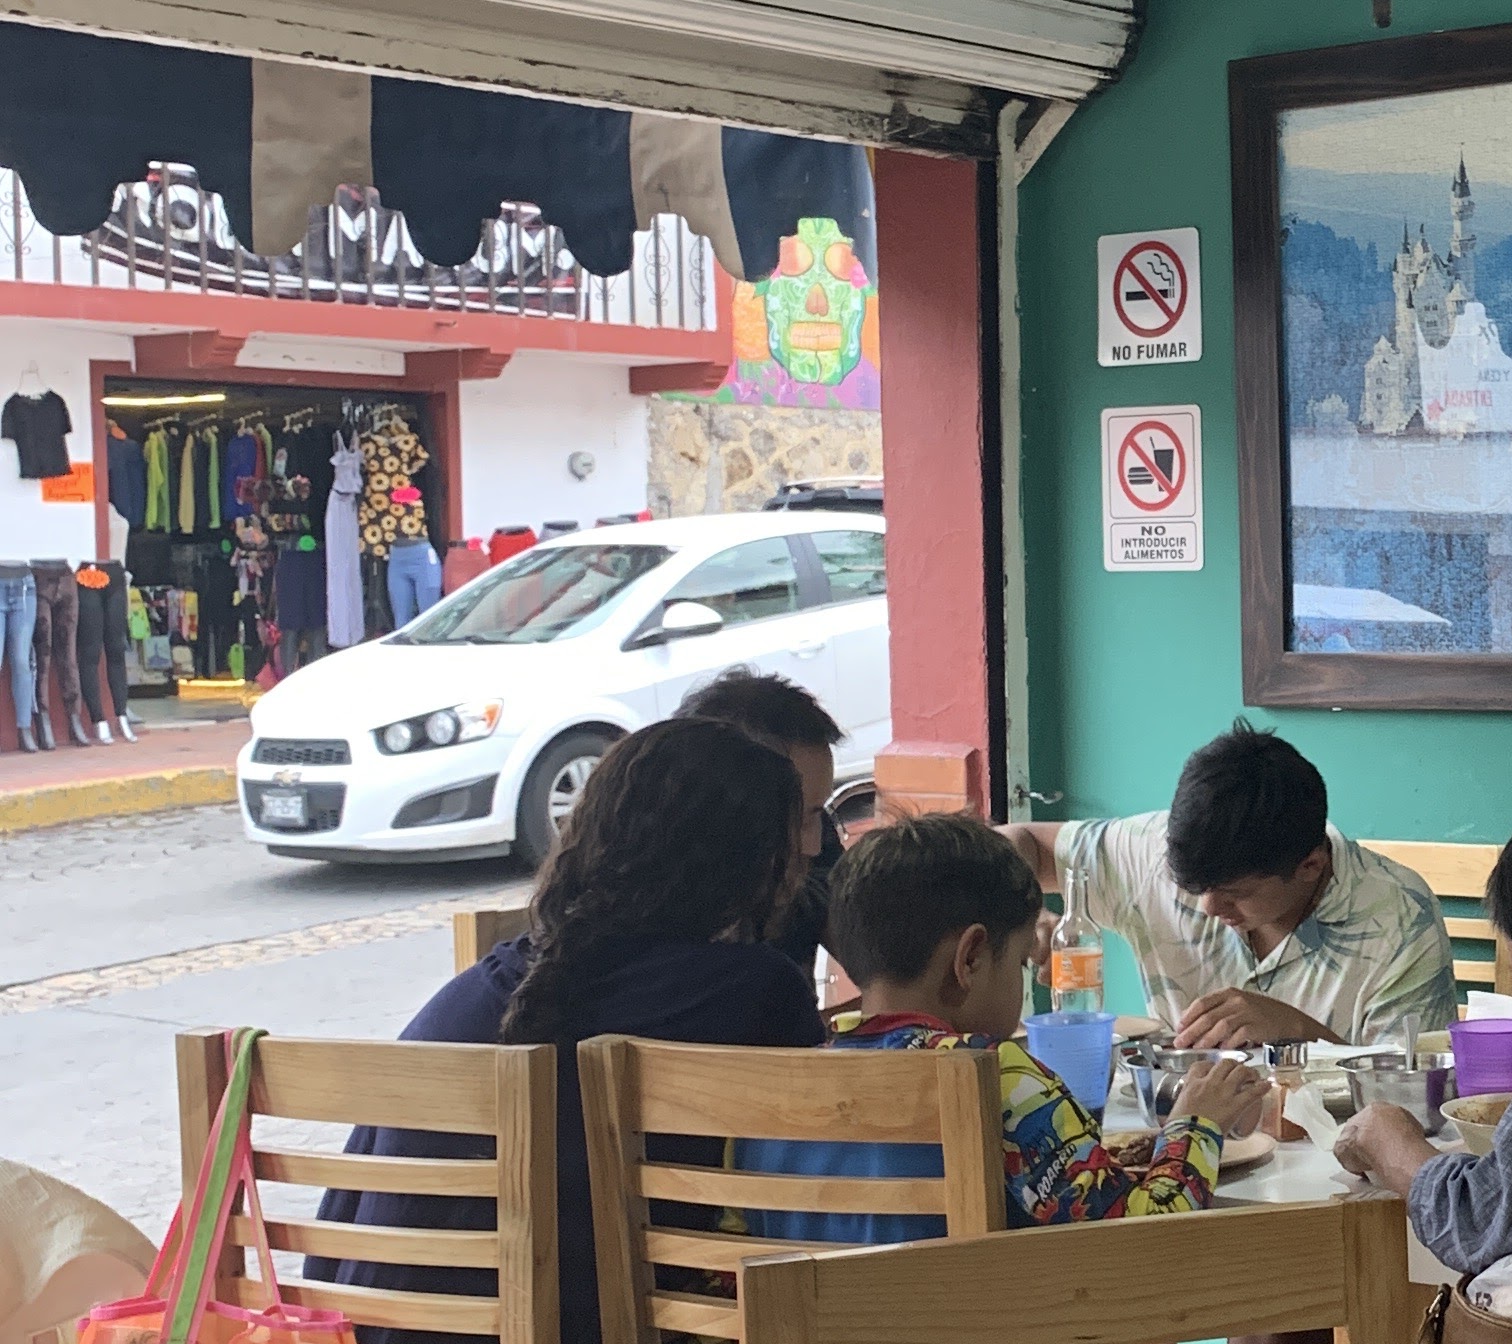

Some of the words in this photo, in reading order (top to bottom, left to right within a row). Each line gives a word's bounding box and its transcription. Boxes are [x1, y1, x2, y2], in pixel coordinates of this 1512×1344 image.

[1112, 346, 1132, 361] NO
[1137, 342, 1187, 360] FUMAR
[1141, 525, 1167, 536] NO
[1121, 537, 1187, 548] INTRODUCIR
[1124, 549, 1185, 560] ALIMENTOS
